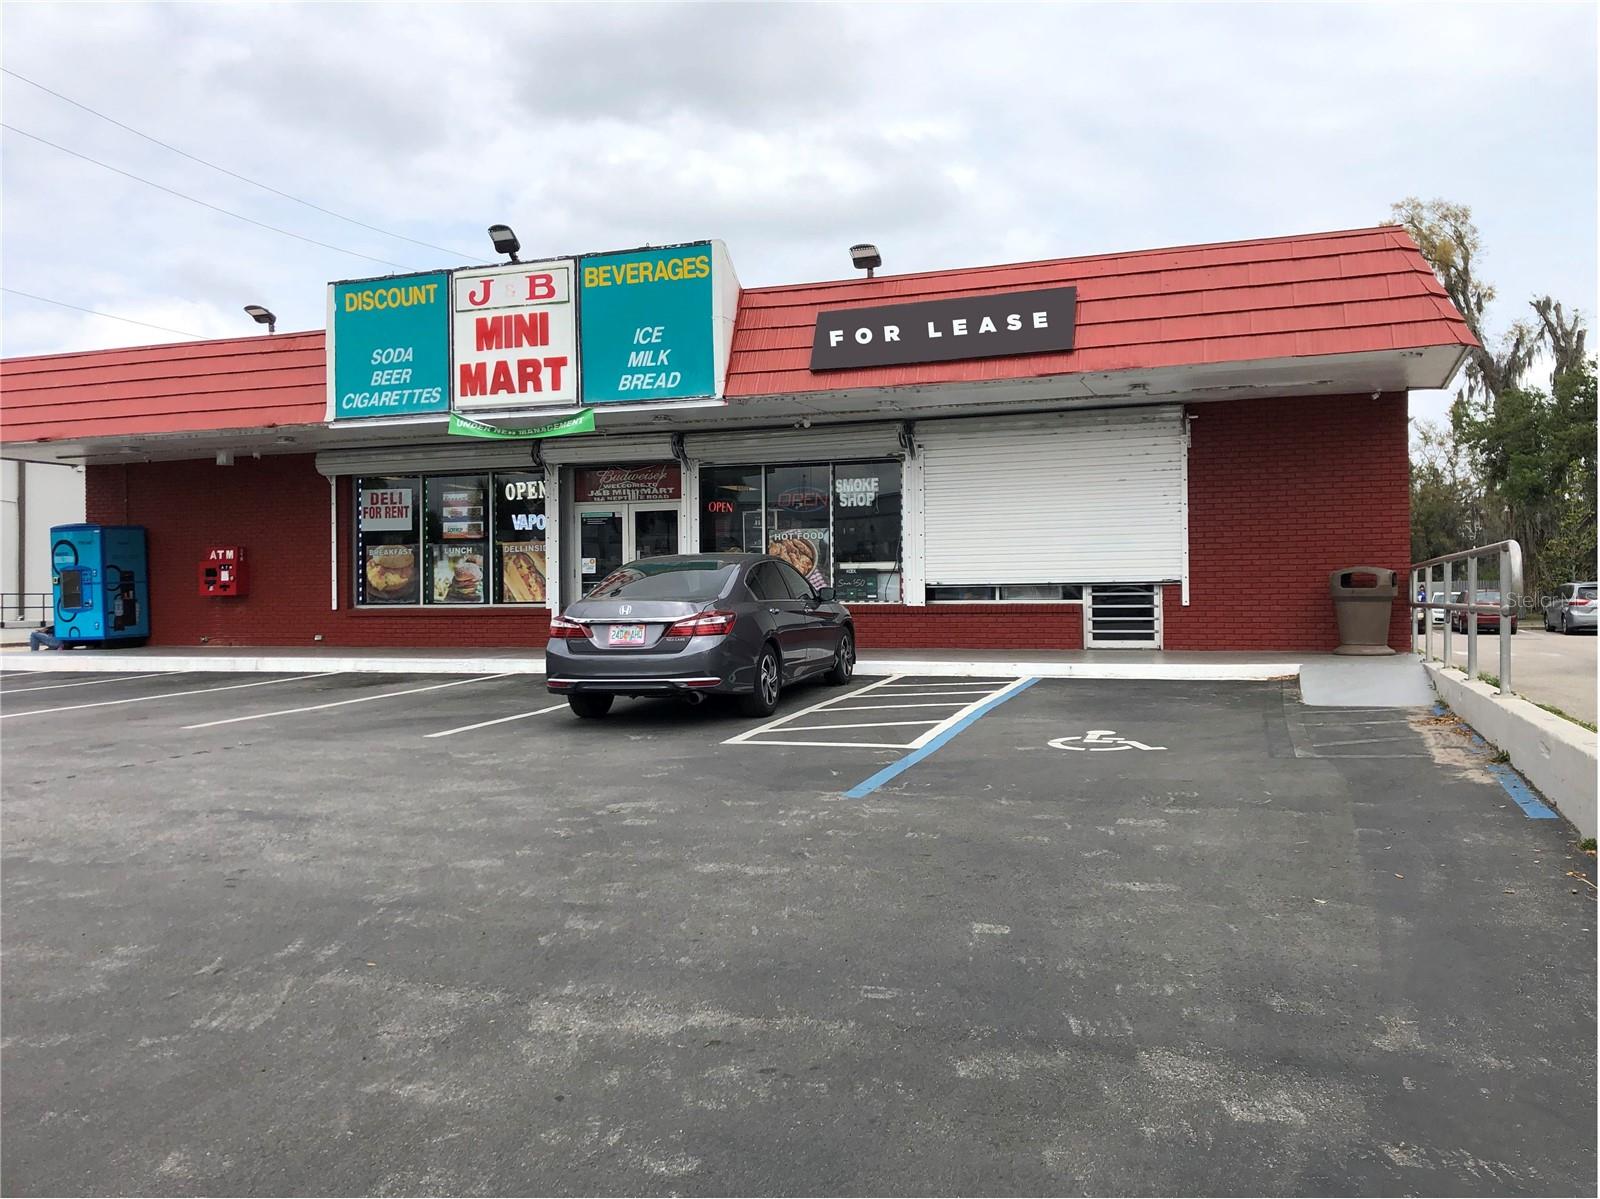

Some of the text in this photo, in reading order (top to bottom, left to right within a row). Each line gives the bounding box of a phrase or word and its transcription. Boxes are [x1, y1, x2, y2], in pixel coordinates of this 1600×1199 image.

[584, 255, 710, 288] BEVERAGES
[345, 284, 438, 312] DISCOUNT
[469, 279, 494, 307] J
[525, 273, 556, 300] B
[475, 312, 549, 352] MINI
[633, 326, 665, 345] ICE
[829, 311, 1049, 347] FOR LEASE
[370, 347, 414, 365] SODA
[627, 349, 671, 368] MILK
[370, 369, 412, 386] BEER
[459, 356, 568, 397] MART
[618, 372, 681, 391] BREAD
[342, 387, 442, 410] CIGARETTES
[456, 418, 494, 432] UNDER
[597, 466, 667, 484] Budweiser
[505, 480, 546, 501] OPEN
[640, 487, 675, 495] MART
[834, 477, 880, 493] SMOKE
[370, 491, 403, 506] DELI
[708, 501, 734, 513] OPEN
[777, 491, 829, 508] OPEN
[839, 492, 877, 507] SHOP
[363, 505, 410, 520] FOR RENT
[774, 530, 824, 541] HOT FOOD
[209, 549, 234, 560] ATM
[369, 548, 413, 556] BREAKFAST
[444, 546, 473, 555] LUNCH
[504, 545, 524, 553] DELI
